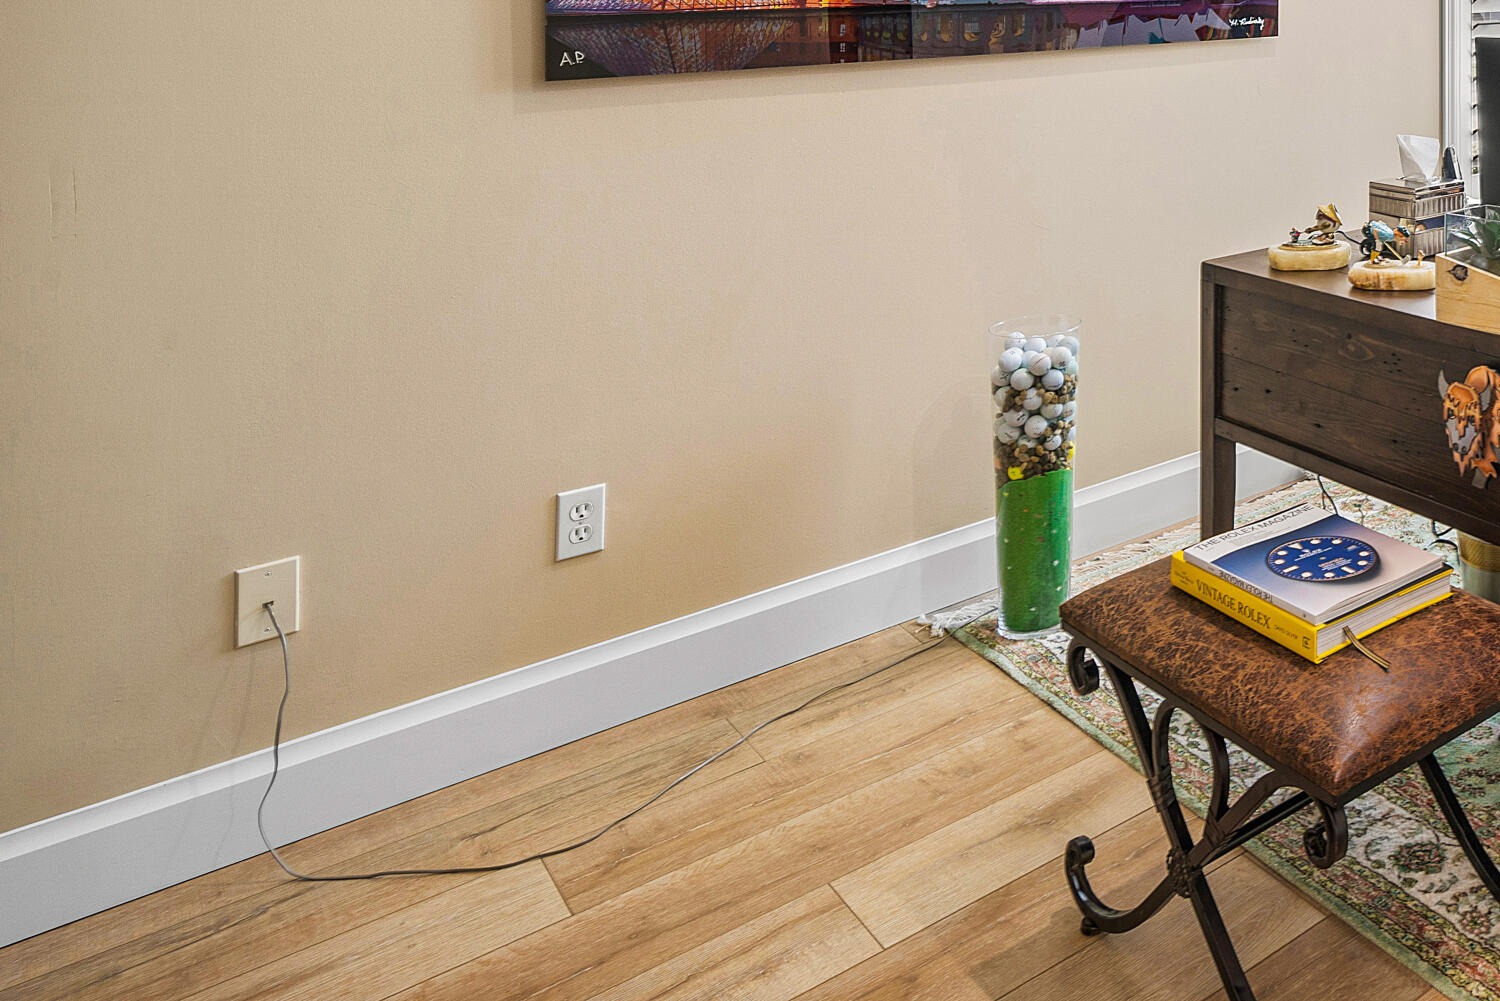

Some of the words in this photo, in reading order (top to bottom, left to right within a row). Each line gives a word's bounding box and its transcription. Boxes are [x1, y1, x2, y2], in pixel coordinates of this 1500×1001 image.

[1194, 537, 1221, 551] THE
[1221, 525, 1258, 542] ROLEX
[1258, 504, 1314, 529] MAGAZINE
[1196, 579, 1237, 610] VINTAGE
[1237, 601, 1272, 630] ROLEX
